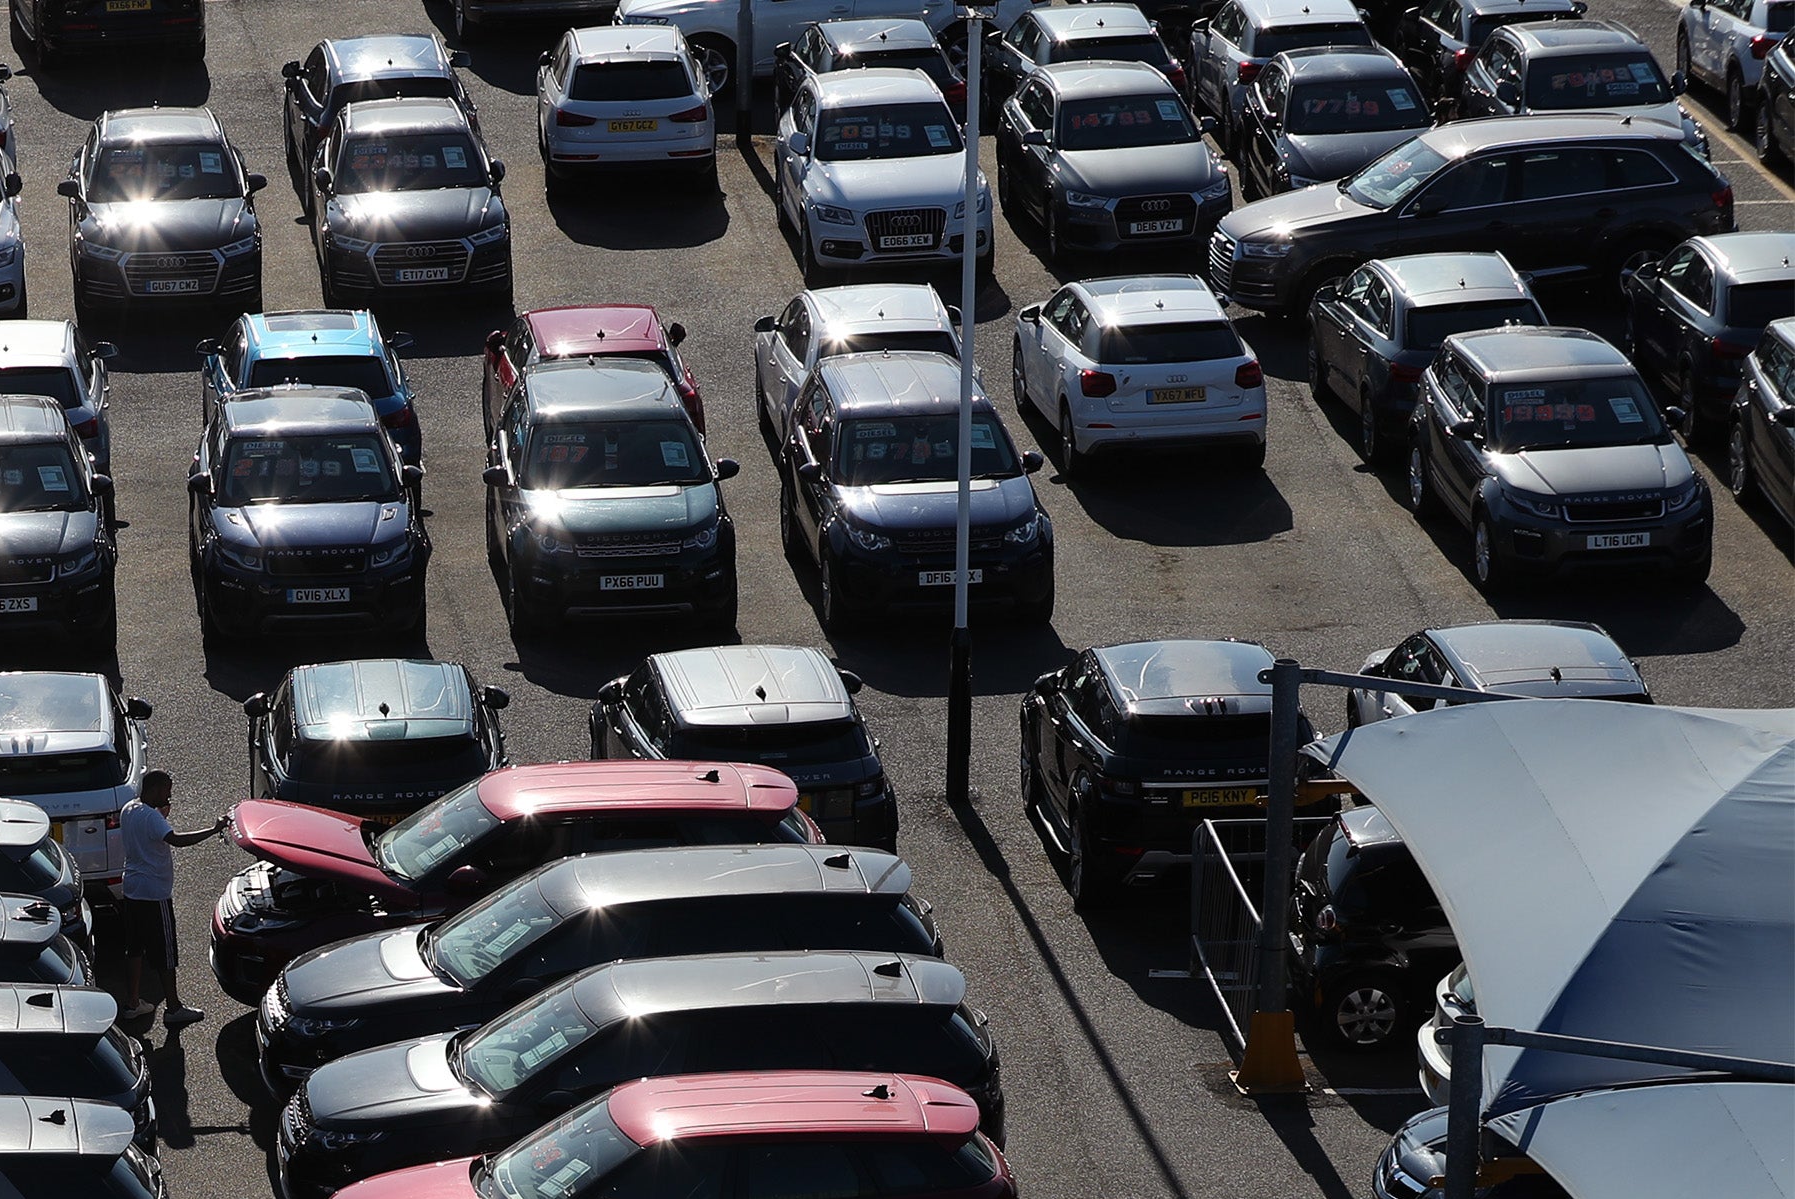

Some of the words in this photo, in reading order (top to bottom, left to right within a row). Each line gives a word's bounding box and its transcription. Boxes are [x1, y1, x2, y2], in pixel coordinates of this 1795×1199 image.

[856, 429, 896, 439] DIESEL
[1594, 536, 1619, 547] LT16
[1622, 534, 1643, 546] UCN
[322, 547, 365, 555] ROVER
[604, 577, 634, 588] PX66
[636, 576, 659, 587] PUU
[925, 572, 951, 584] DF16
[296, 590, 321, 601] GV16
[323, 589, 346, 600] XLX
[8, 599, 30, 610] ZXS
[1227, 766, 1267, 774] ROVE
[792, 773, 831, 782] OVER
[1191, 792, 1219, 804] PG16
[1222, 790, 1248, 803] KNY
